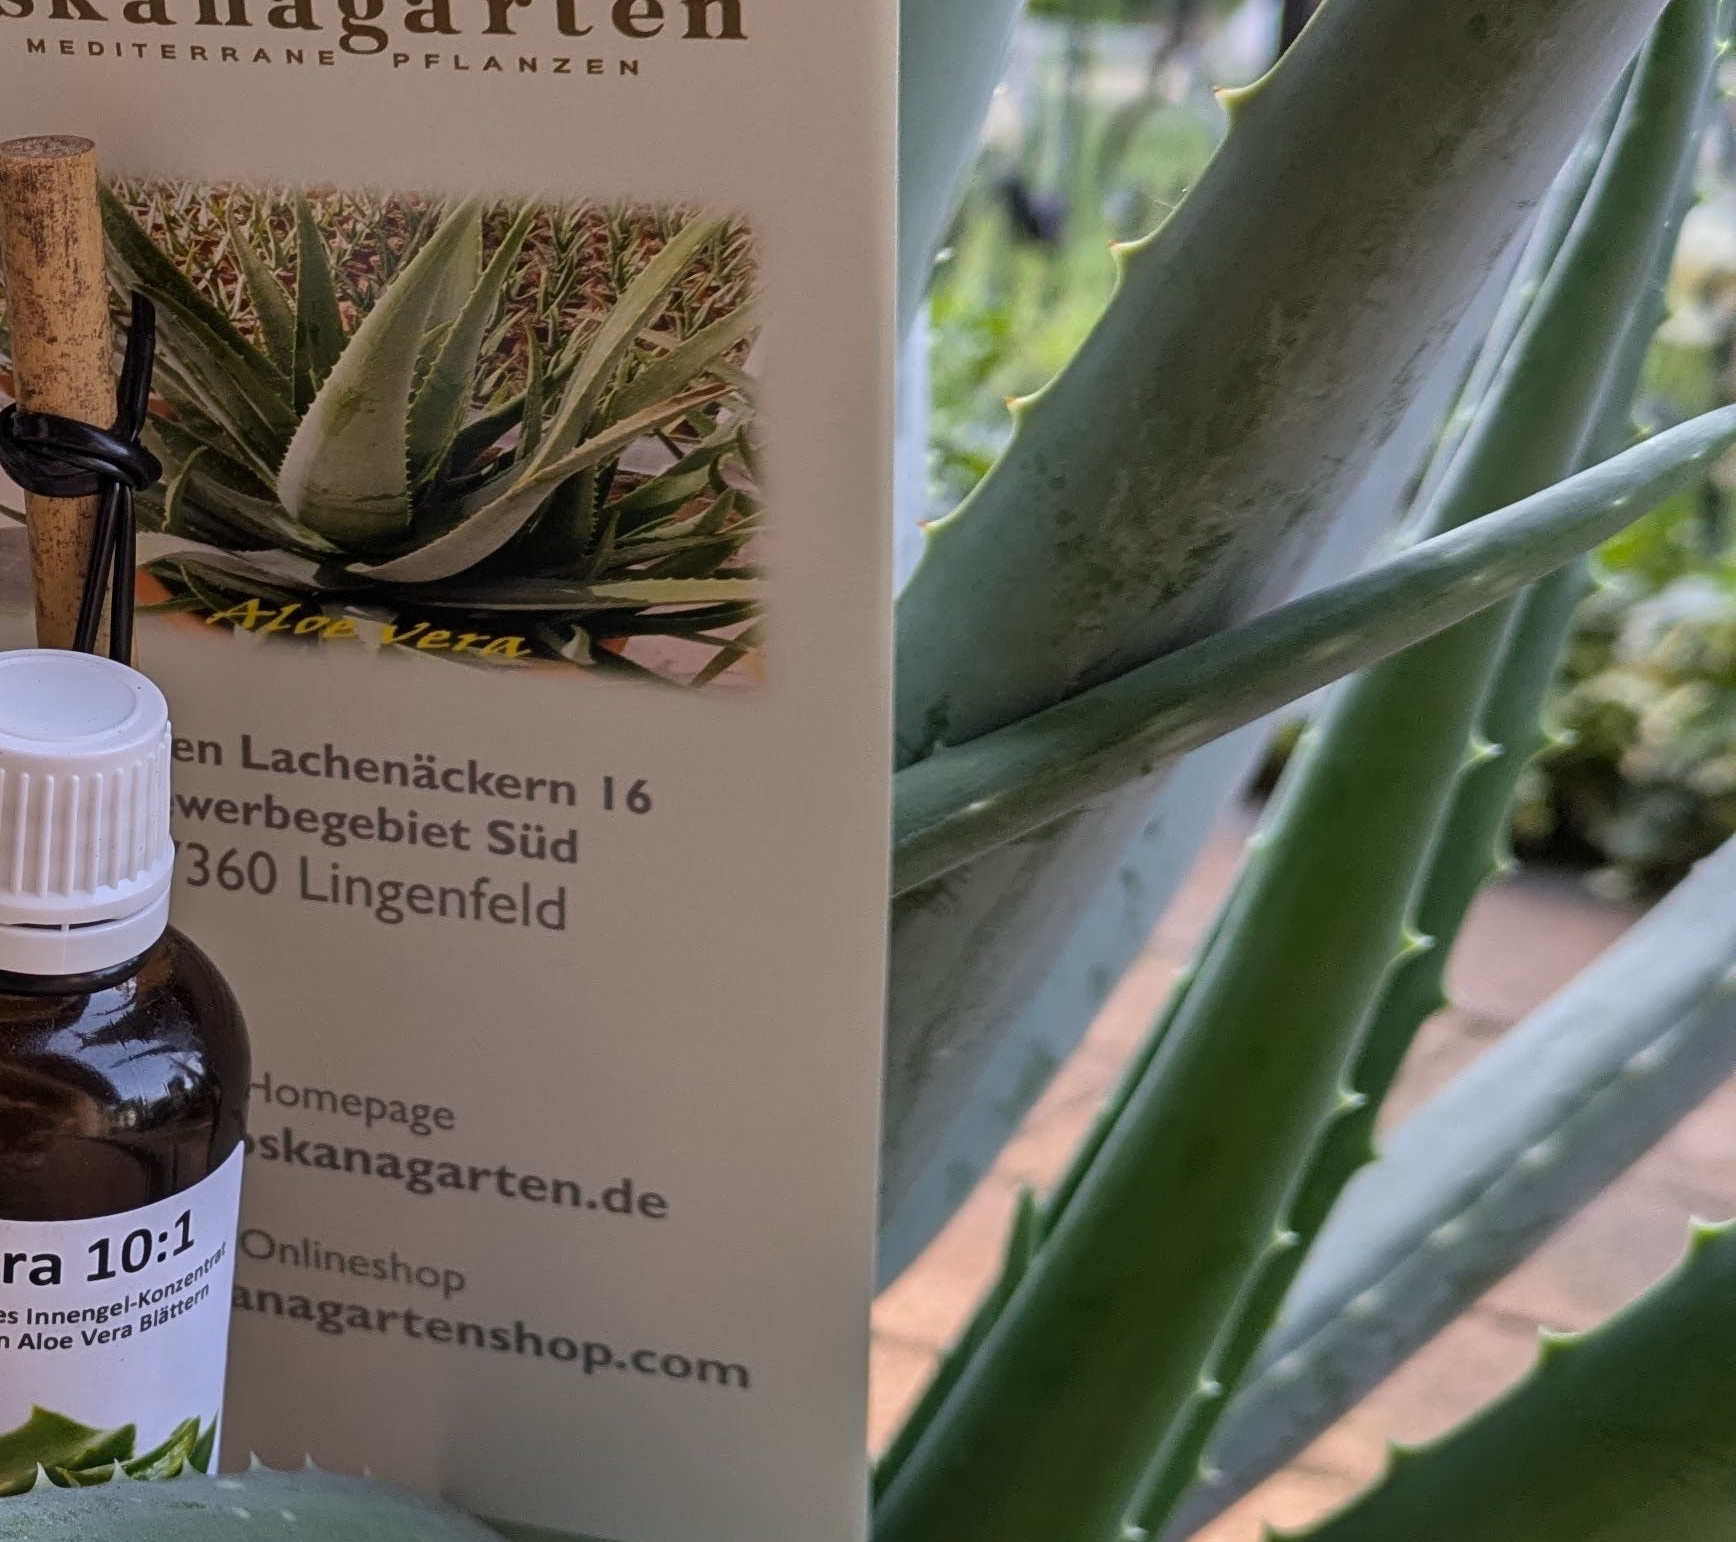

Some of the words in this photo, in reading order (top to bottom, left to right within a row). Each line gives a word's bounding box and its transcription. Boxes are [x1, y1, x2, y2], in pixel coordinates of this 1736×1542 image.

[26, 37, 336, 67] MEDITERRANE
[392, 53, 640, 77] PFLANZEN
[206, 598, 358, 639] Aloe
[240, 734, 577, 806] Lachenäckern
[602, 775, 653, 815] 16
[170, 793, 471, 852] werbegebiet
[487, 819, 579, 864] Süd
[173, 839, 277, 896] 360
[299, 856, 567, 931] Lingenfeld
[86, 1209, 195, 1282] 10:1
[240, 1228, 466, 1299] Onlineshop
[17, 1332, 73, 1350] Aloe
[81, 1323, 133, 1347] Vera
[139, 1282, 210, 1333] Blättern
[26, 1241, 227, 1325] Innengel-Konzentrat
